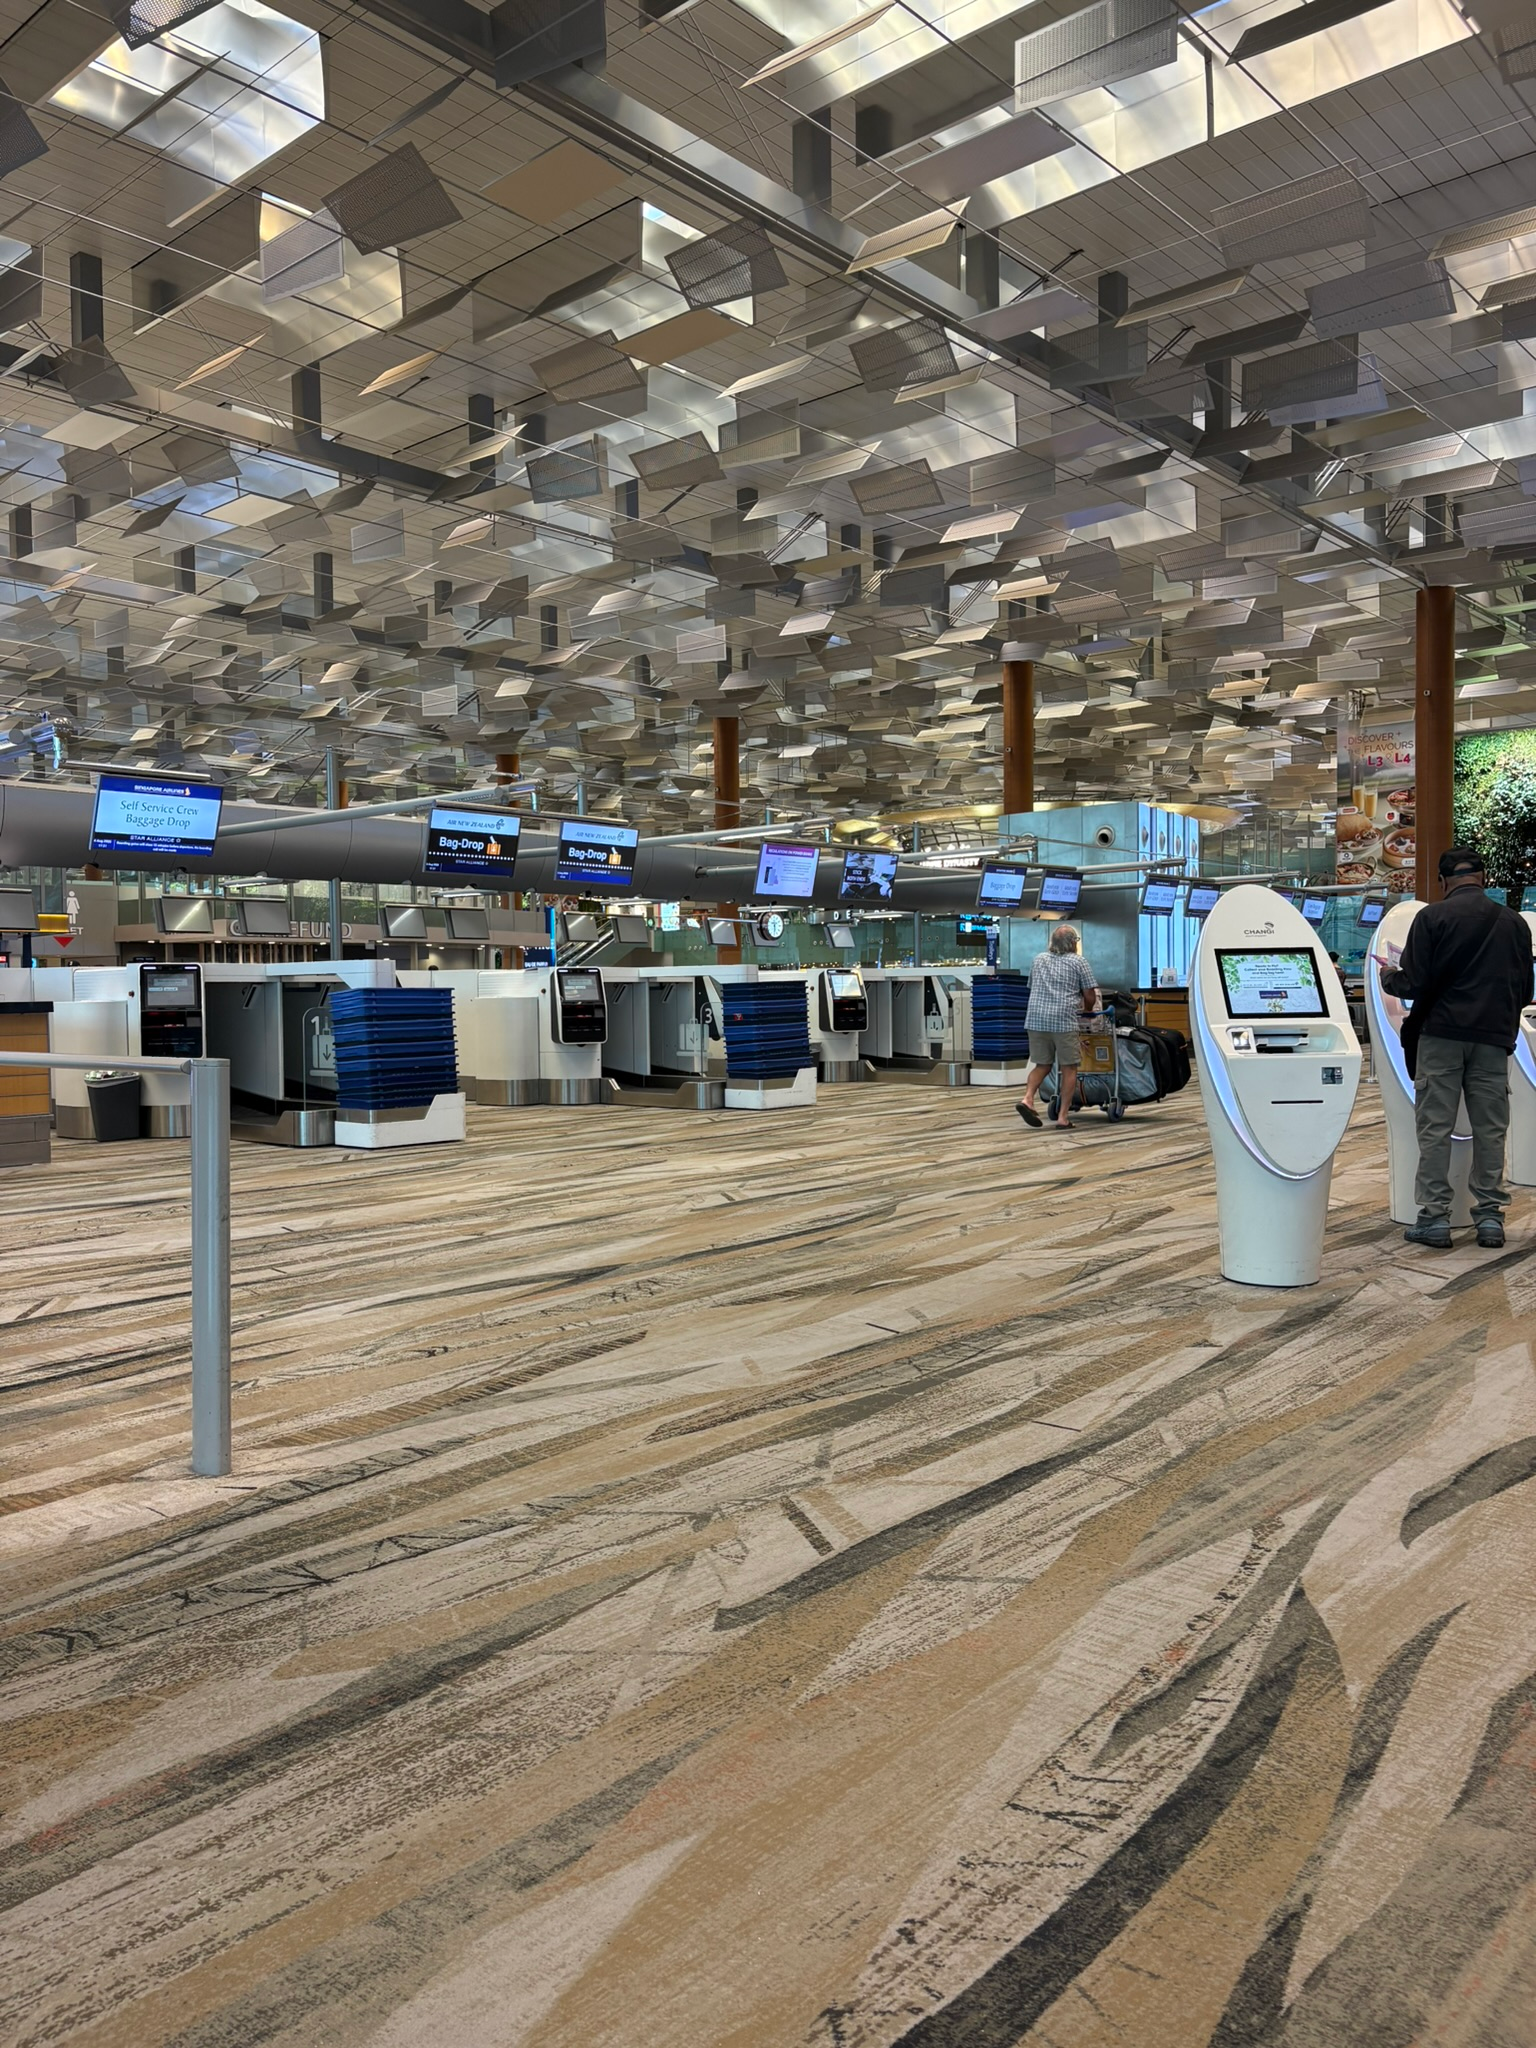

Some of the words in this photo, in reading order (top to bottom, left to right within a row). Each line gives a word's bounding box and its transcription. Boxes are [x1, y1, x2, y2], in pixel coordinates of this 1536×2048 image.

[1348, 732, 1394, 745] DISCOVER
[1364, 741, 1414, 753] FLAVOURS
[1367, 755, 1384, 767] L3
[1394, 752, 1411, 763] L4
[120, 800, 139, 811] Self
[141, 802, 174, 814] Service
[176, 805, 199, 815] Crew
[126, 814, 165, 827] Baggage
[167, 817, 191, 830] Drop
[439, 836, 484, 852] Bag-Drop
[568, 847, 607, 862] Bag-Drop
[833, 911, 839, 920] D
[704, 1008, 713, 1024] 3
[311, 1015, 320, 1035] 1
